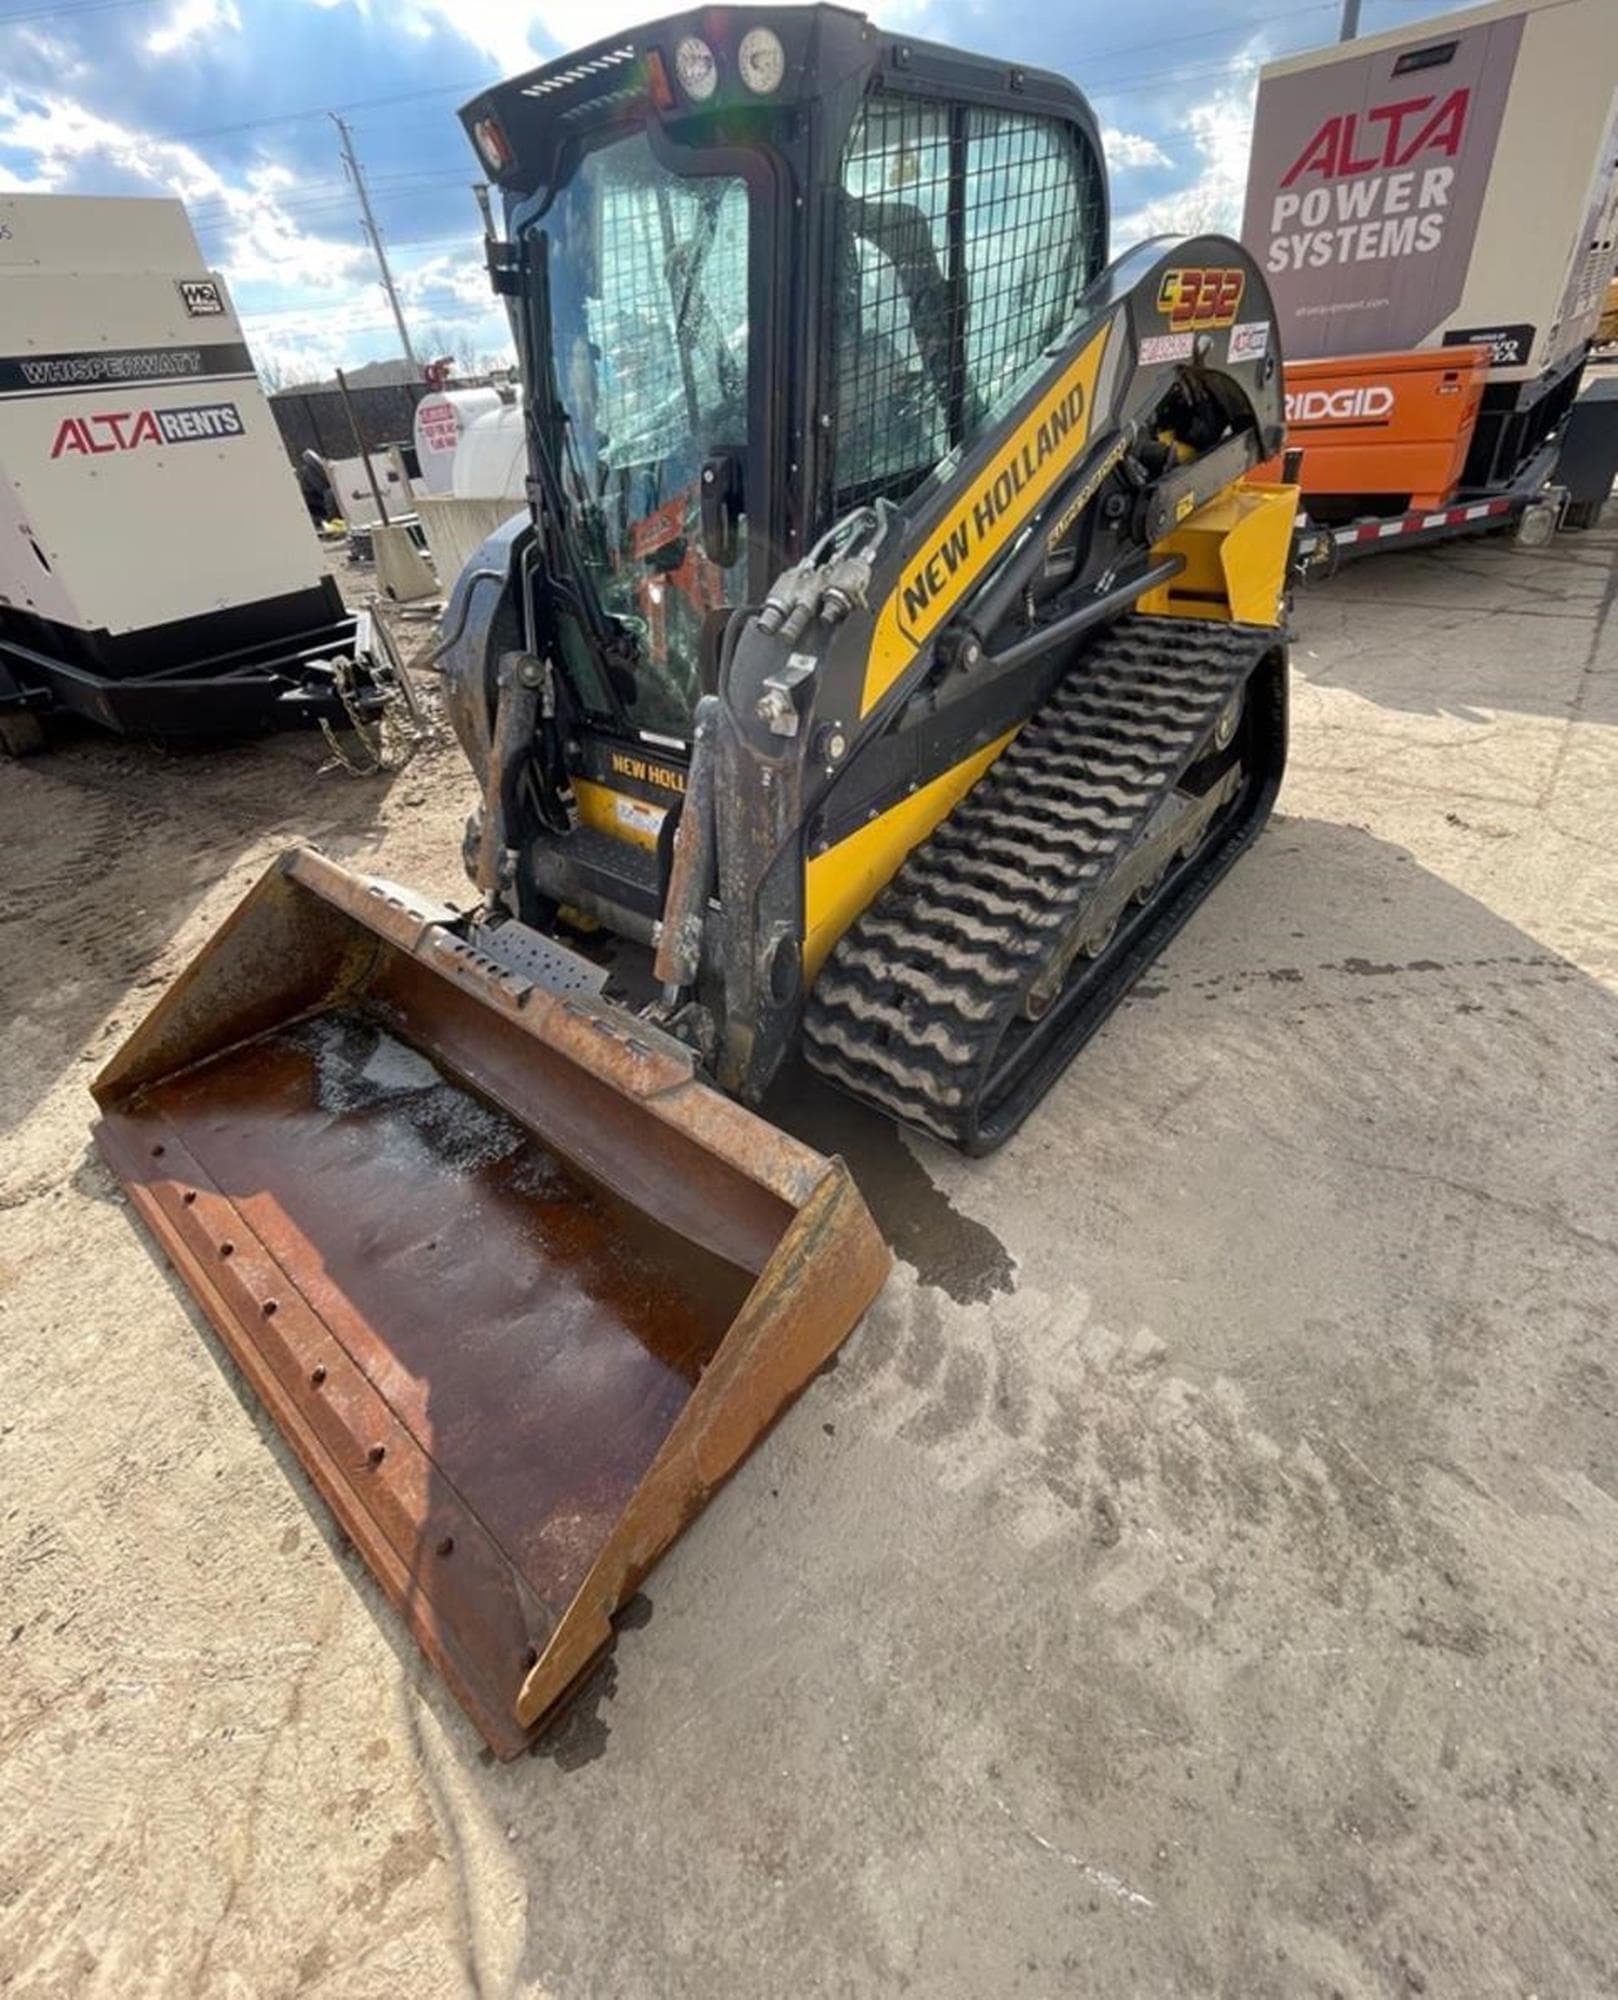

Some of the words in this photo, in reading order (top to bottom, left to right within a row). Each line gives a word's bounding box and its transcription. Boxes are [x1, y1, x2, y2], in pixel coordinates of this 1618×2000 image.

[1280, 87, 1470, 189] ALTA
[1271, 166, 1454, 234] POWER
[1267, 213, 1443, 273] SYSTEMS
[1159, 271, 1244, 326] C332
[20, 352, 202, 384] WHISPERWATT
[1285, 386, 1394, 421] RIDGID
[51, 411, 163, 459] ALTA
[161, 409, 240, 440] RENTS
[902, 521, 969, 623] NEW
[972, 382, 1085, 540] HOLLAND
[612, 753, 646, 780] NEW
